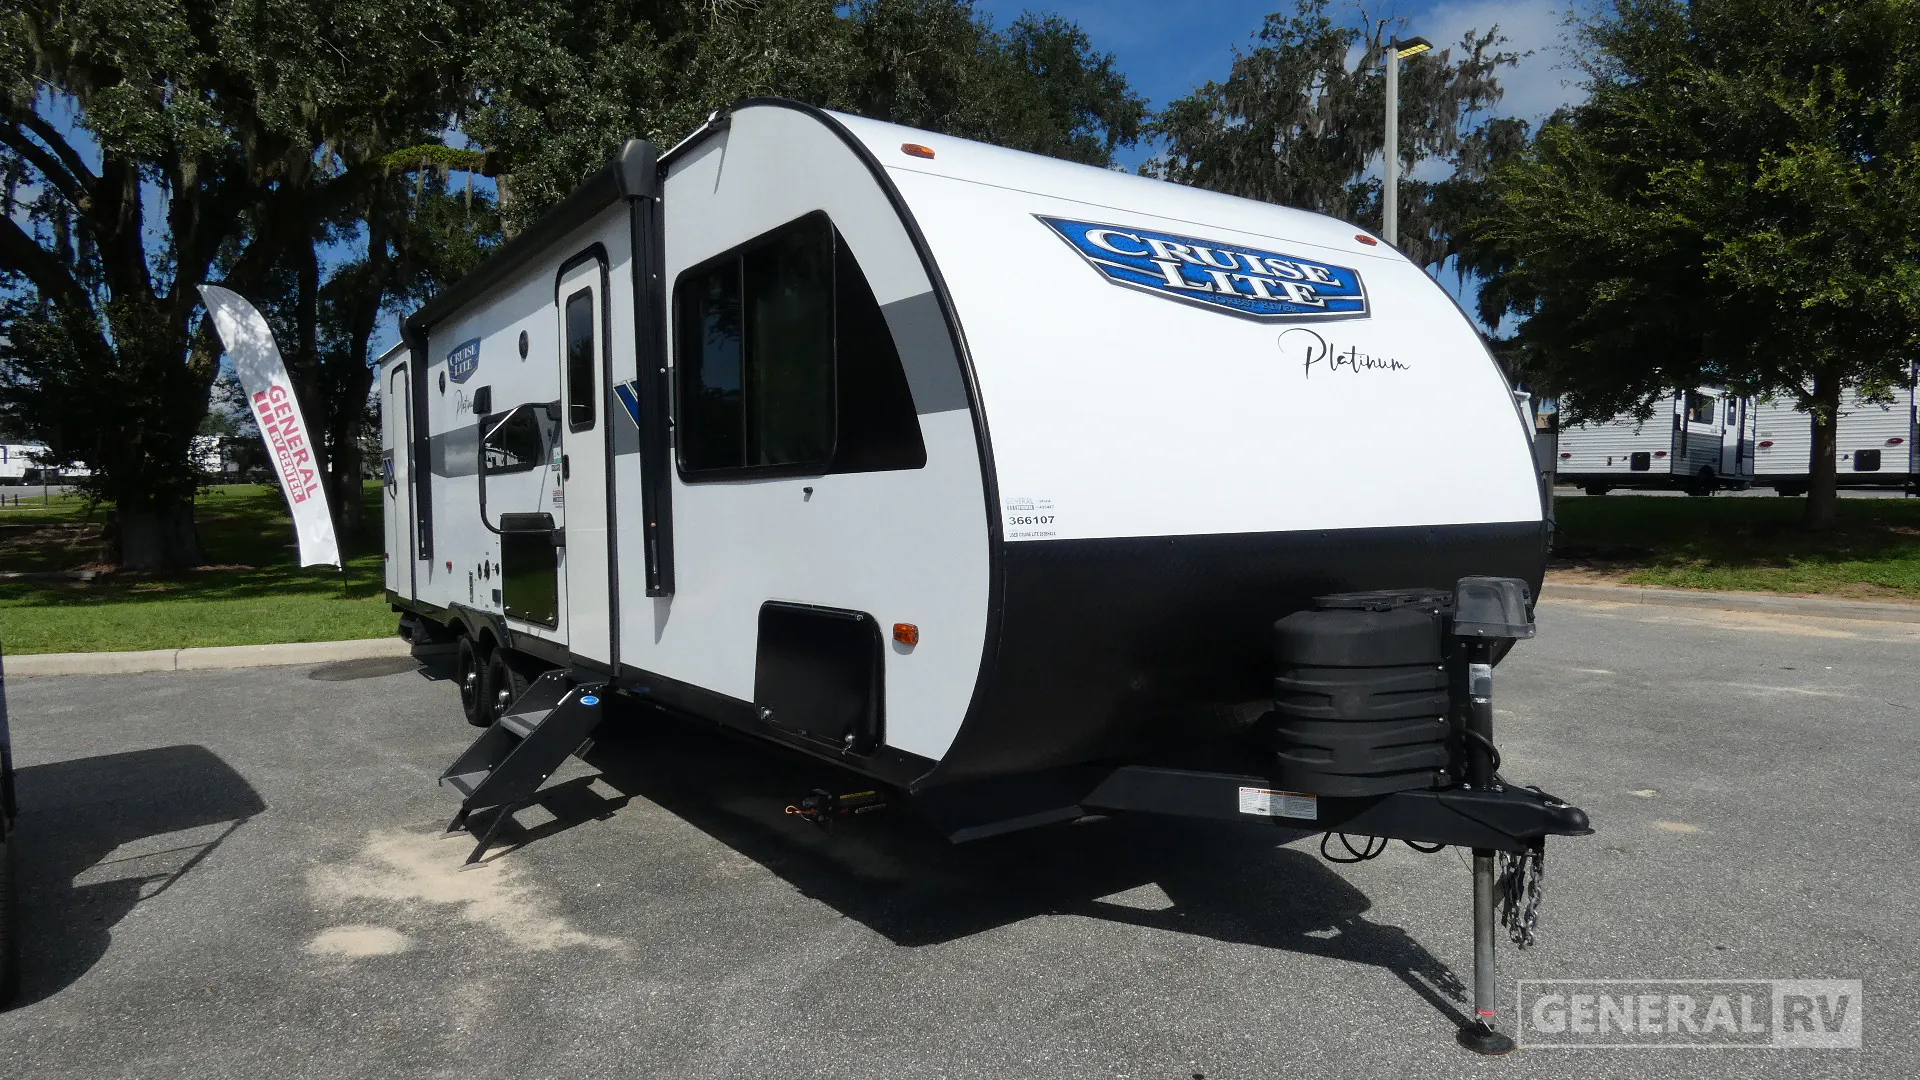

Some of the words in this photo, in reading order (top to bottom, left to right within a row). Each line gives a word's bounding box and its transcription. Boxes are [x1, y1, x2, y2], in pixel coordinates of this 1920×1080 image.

[1085, 229, 1341, 287] CRUISE
[1149, 259, 1326, 308] LITE
[449, 343, 477, 367] CRUISE
[454, 358, 472, 377] LITE
[1278, 328, 1411, 380] Platinum
[269, 385, 318, 499] GENERAL
[271, 430, 285, 447] RV
[279, 449, 304, 498] CENTER
[1008, 515, 1055, 526] 366107
